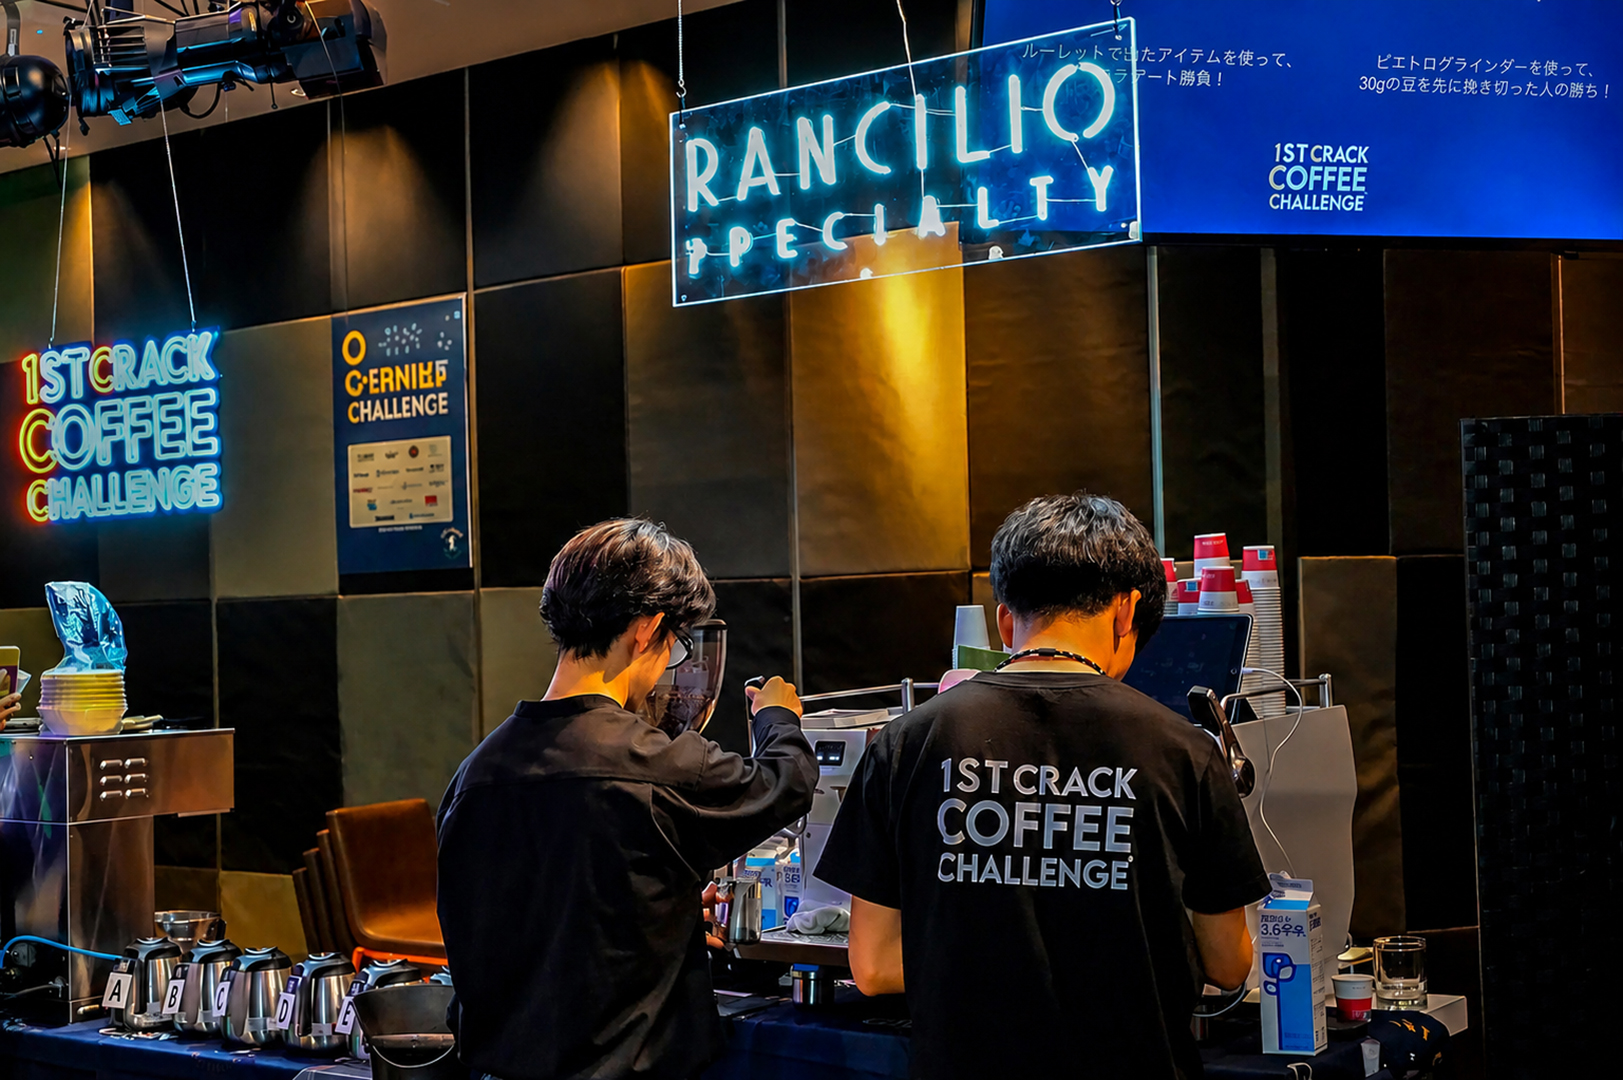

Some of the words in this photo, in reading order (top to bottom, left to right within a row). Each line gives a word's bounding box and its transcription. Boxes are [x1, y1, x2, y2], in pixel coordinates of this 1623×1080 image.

[1376, 53, 1595, 78] ピエトログラインダーを使って、
[686, 62, 1116, 212] RANCILIO
[1274, 142, 1309, 163] 1ST
[1310, 144, 1370, 164] CRACK
[1268, 164, 1368, 192] COFFEE
[1269, 193, 1366, 212] CHALLENGE
[21, 346, 90, 405] 1ST
[88, 331, 216, 393] CRACK
[347, 392, 449, 424] CHALLENGE
[19, 387, 219, 474] COFFEE
[26, 463, 220, 522] CHALLENGE
[940, 757, 1009, 794] 1ST
[1013, 763, 1138, 800] CRACK
[936, 797, 1135, 853] COFFEE
[937, 852, 1130, 890] CHALLENGE
[108, 979, 122, 1002] A
[168, 985, 179, 1009] B
[216, 987, 225, 1011] C
[278, 999, 289, 1023] D
